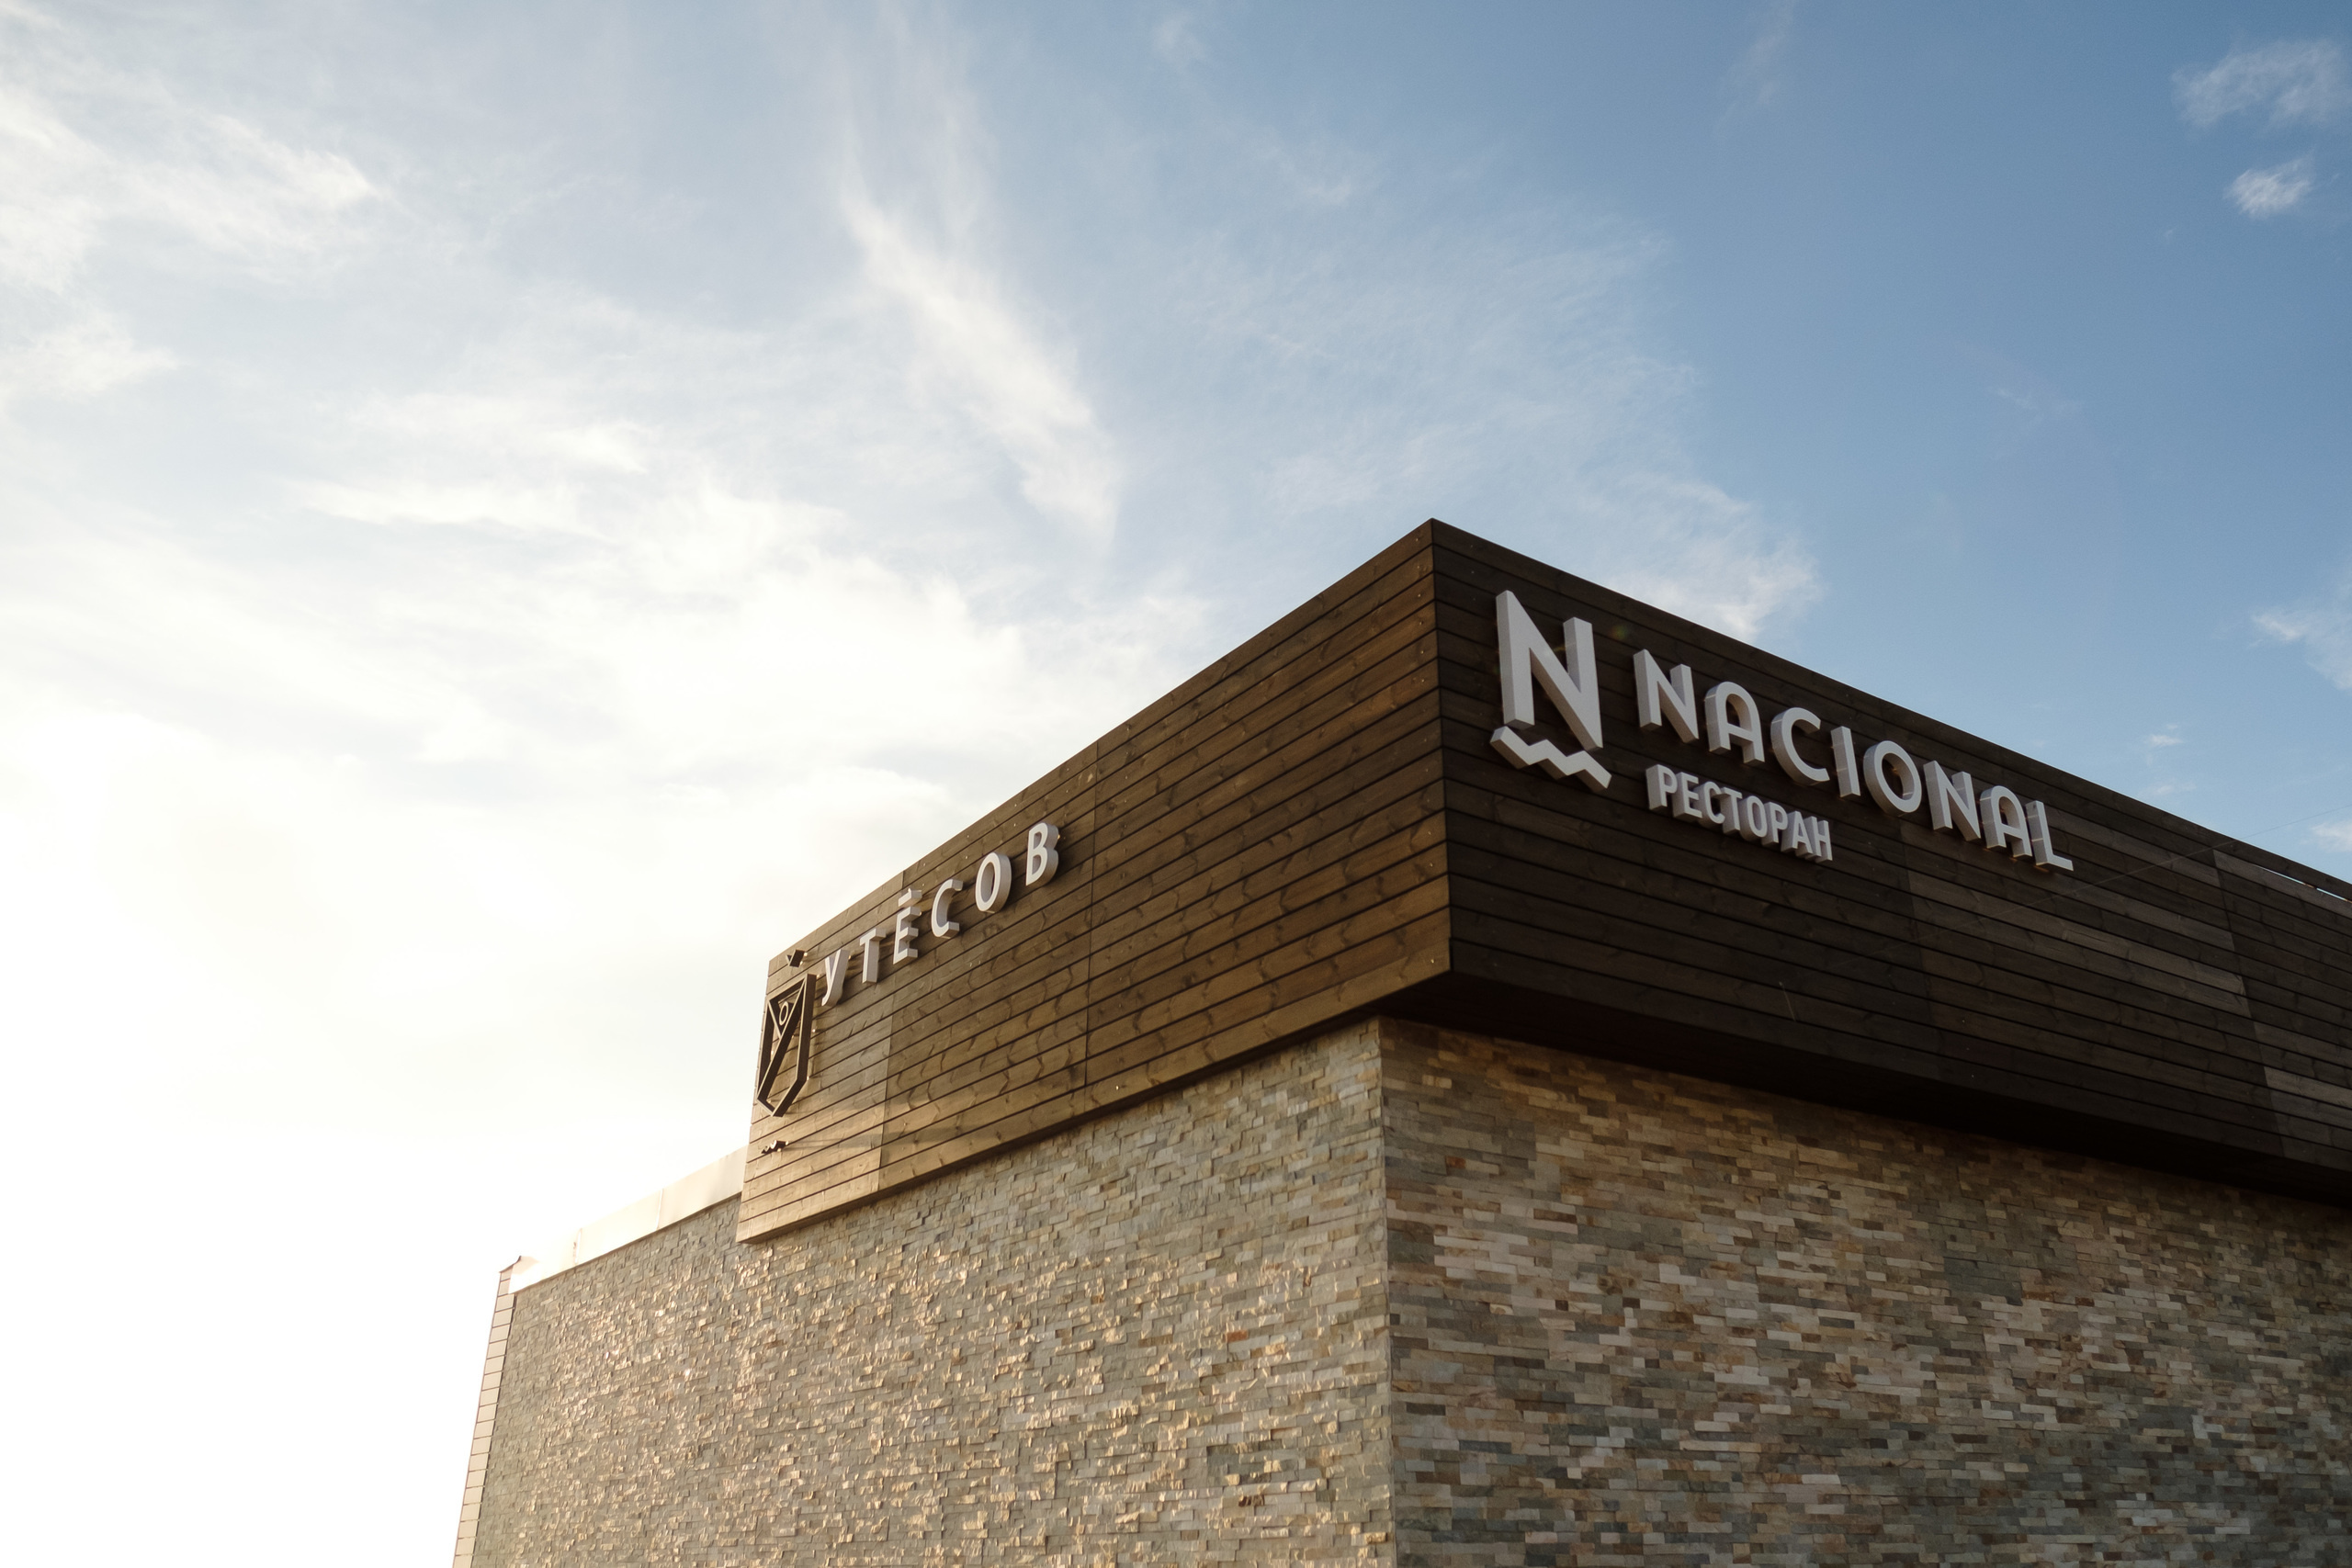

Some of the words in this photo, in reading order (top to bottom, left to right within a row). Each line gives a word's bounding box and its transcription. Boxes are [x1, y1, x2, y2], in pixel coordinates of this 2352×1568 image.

[1496, 590, 1603, 751] N
[1633, 649, 2074, 871] NACIONAL
[1645, 764, 1833, 862] РЕСТОРАН
